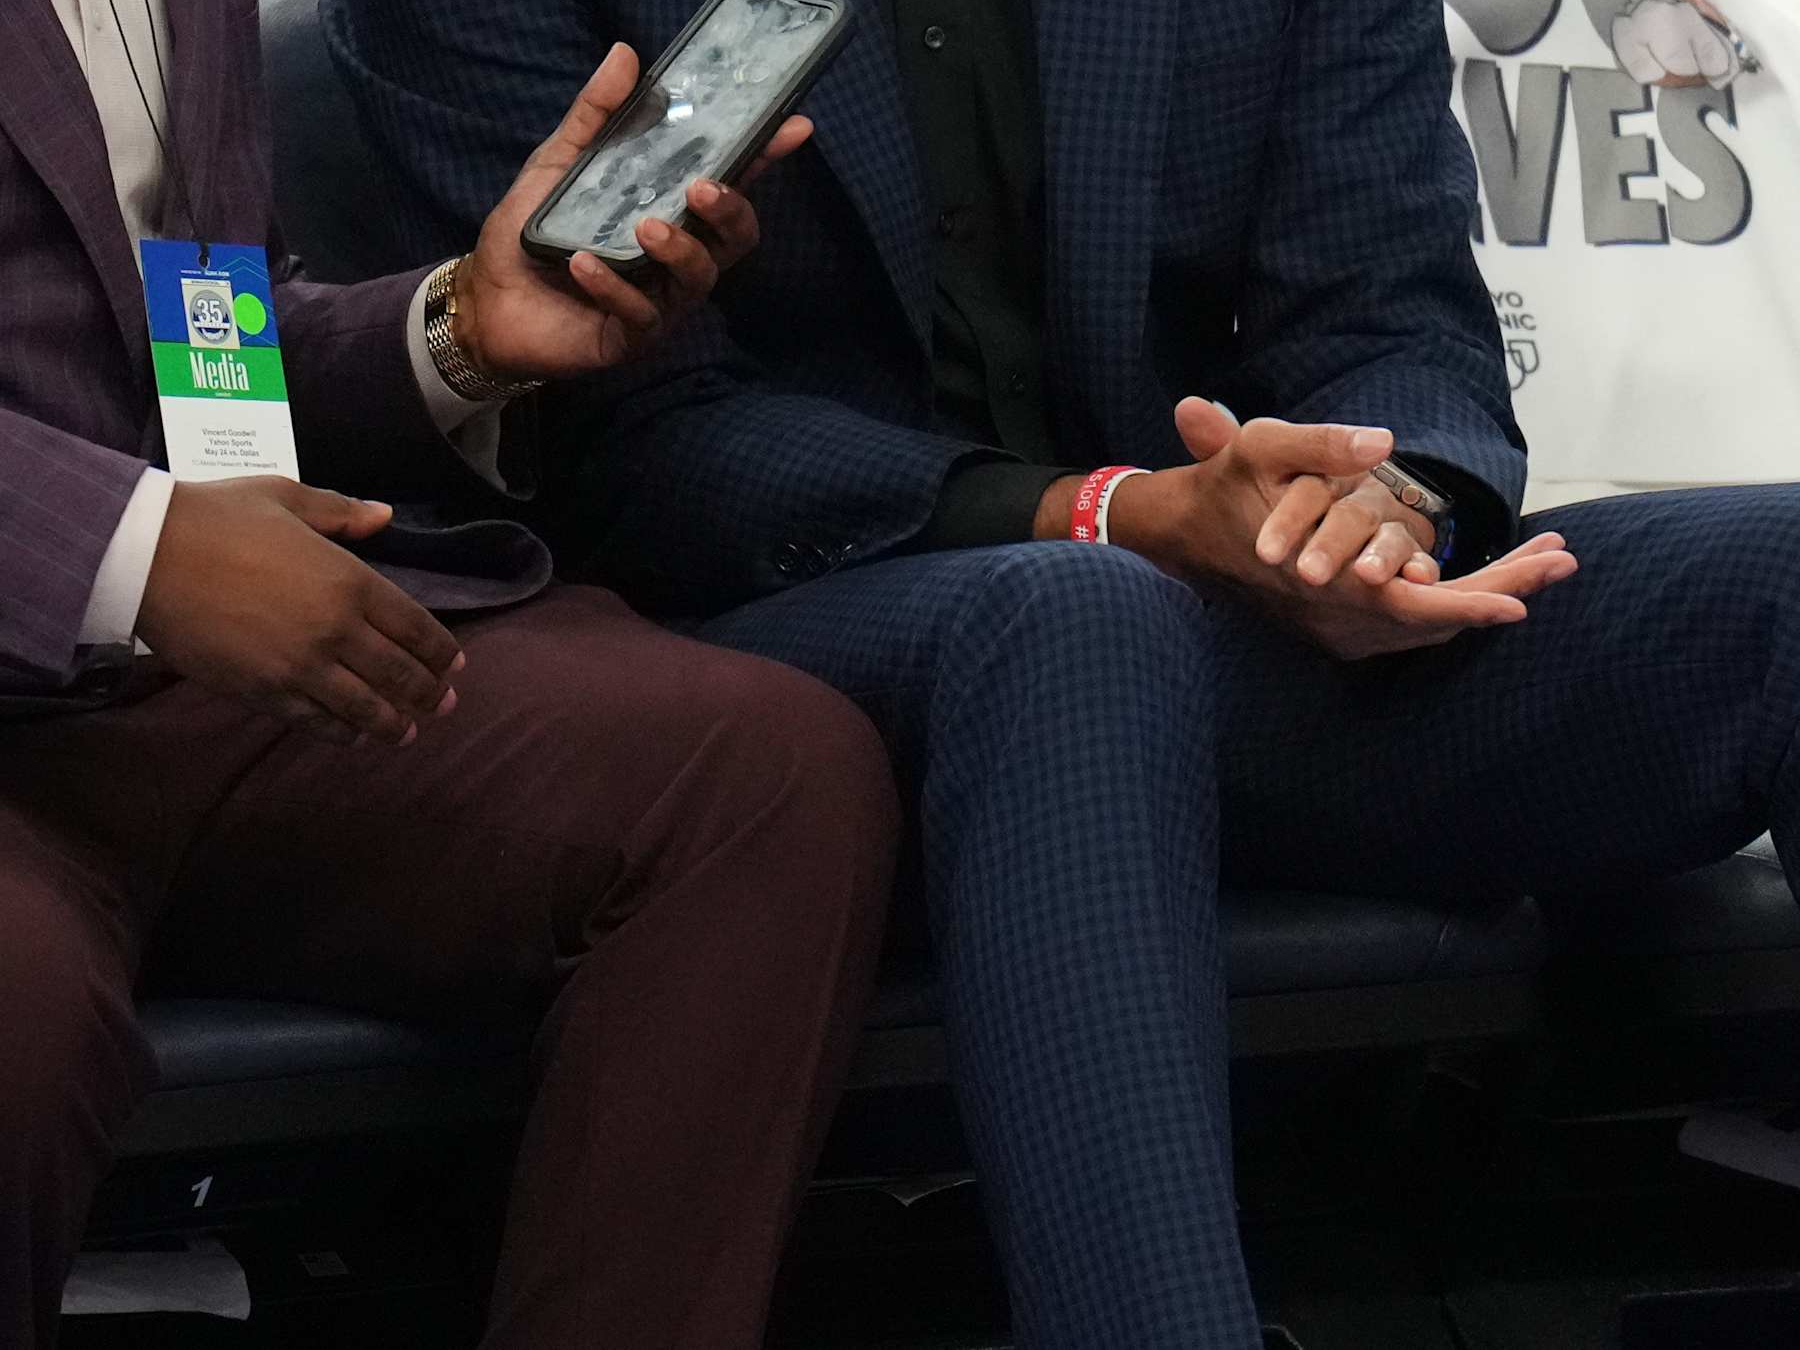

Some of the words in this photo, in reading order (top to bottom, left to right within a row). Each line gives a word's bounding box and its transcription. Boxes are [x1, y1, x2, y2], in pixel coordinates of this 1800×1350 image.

[196, 298, 224, 324] 35
[189, 352, 250, 391] Media
[191, 1174, 214, 1208] 1
